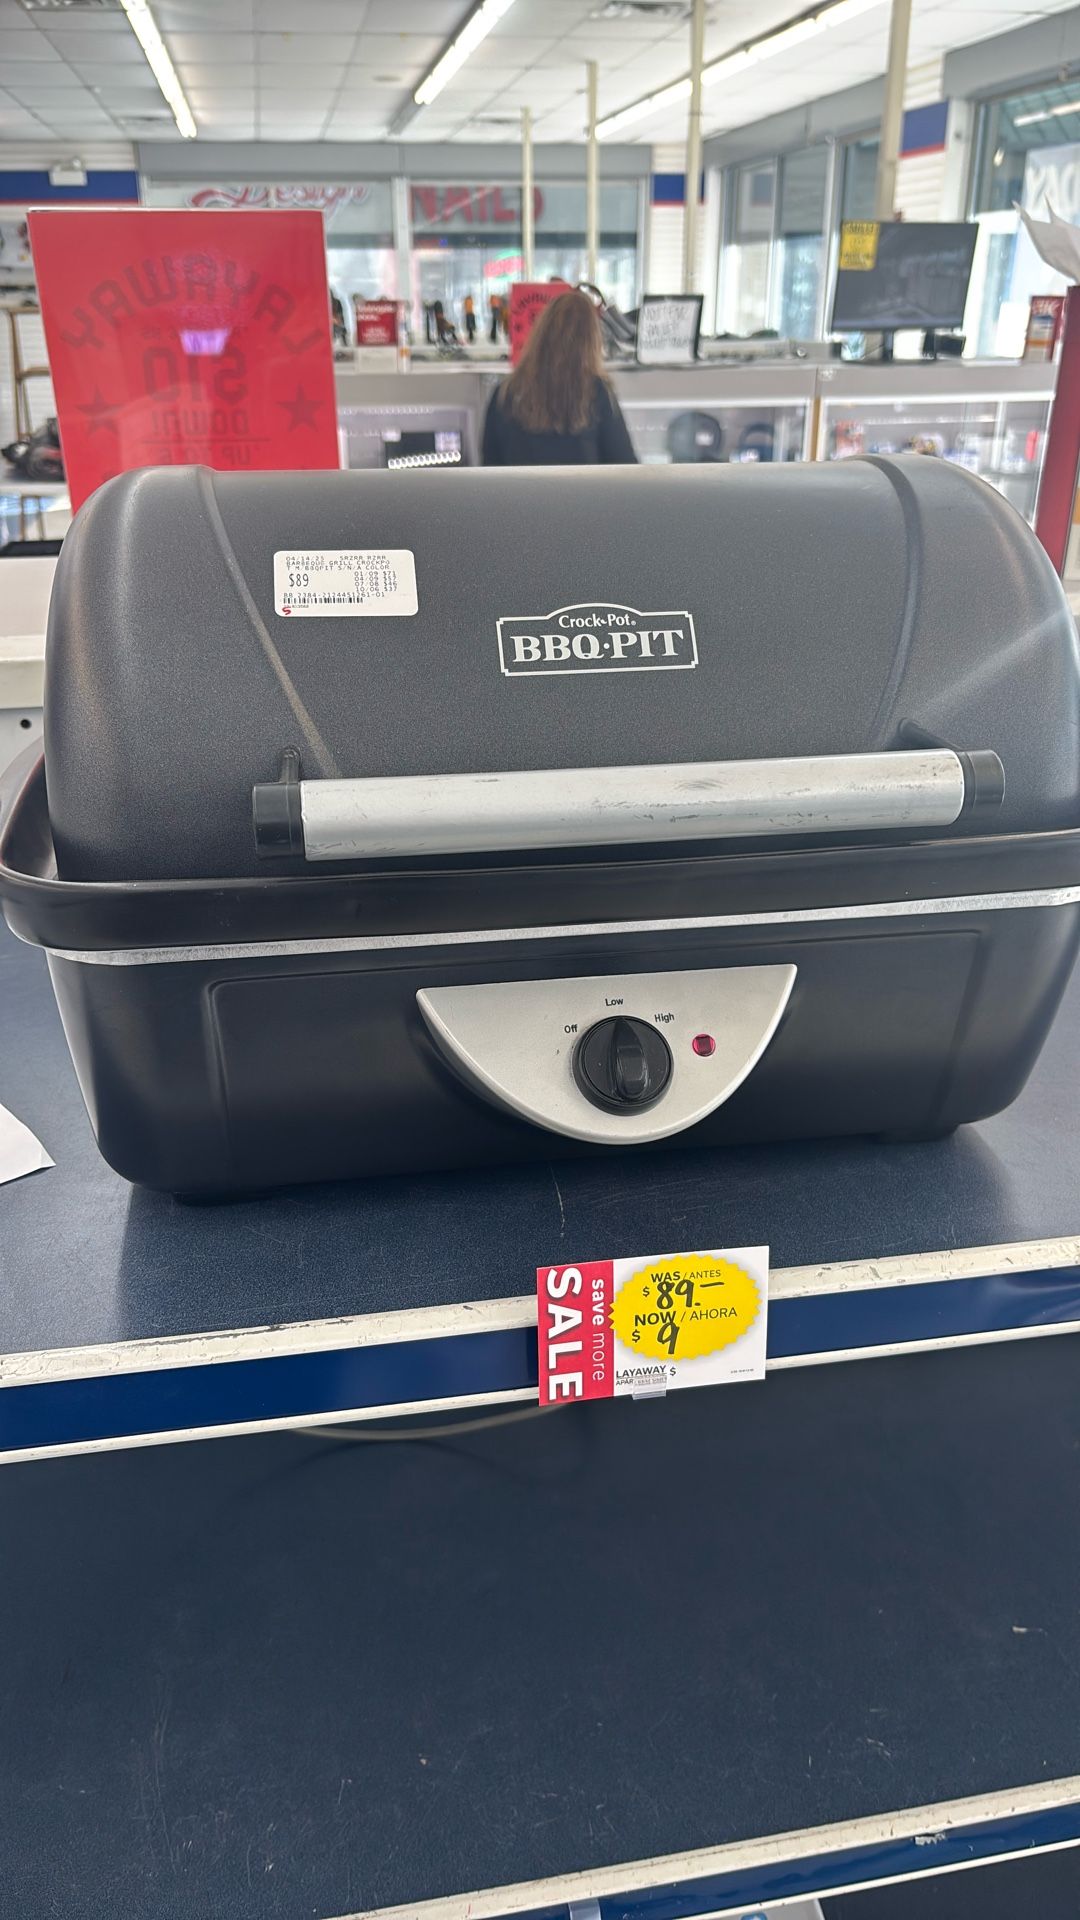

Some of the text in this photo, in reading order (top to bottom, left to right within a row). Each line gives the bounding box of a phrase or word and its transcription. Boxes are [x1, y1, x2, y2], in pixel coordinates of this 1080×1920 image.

[288, 573, 310, 588] $89
[605, 998, 624, 1006] Low
[654, 1012, 675, 1024] High
[564, 1023, 579, 1034] Off
[650, 1271, 681, 1283] WAS
[689, 1269, 722, 1280] ANTES
[642, 1286, 650, 1298] $
[634, 1311, 677, 1326] NOW
[689, 1307, 738, 1322] AHORA
[547, 1267, 583, 1401] SALE
[591, 1279, 605, 1381] save more
[631, 1323, 681, 1355] $ 9
[615, 1365, 677, 1379] LAYAWAY $
